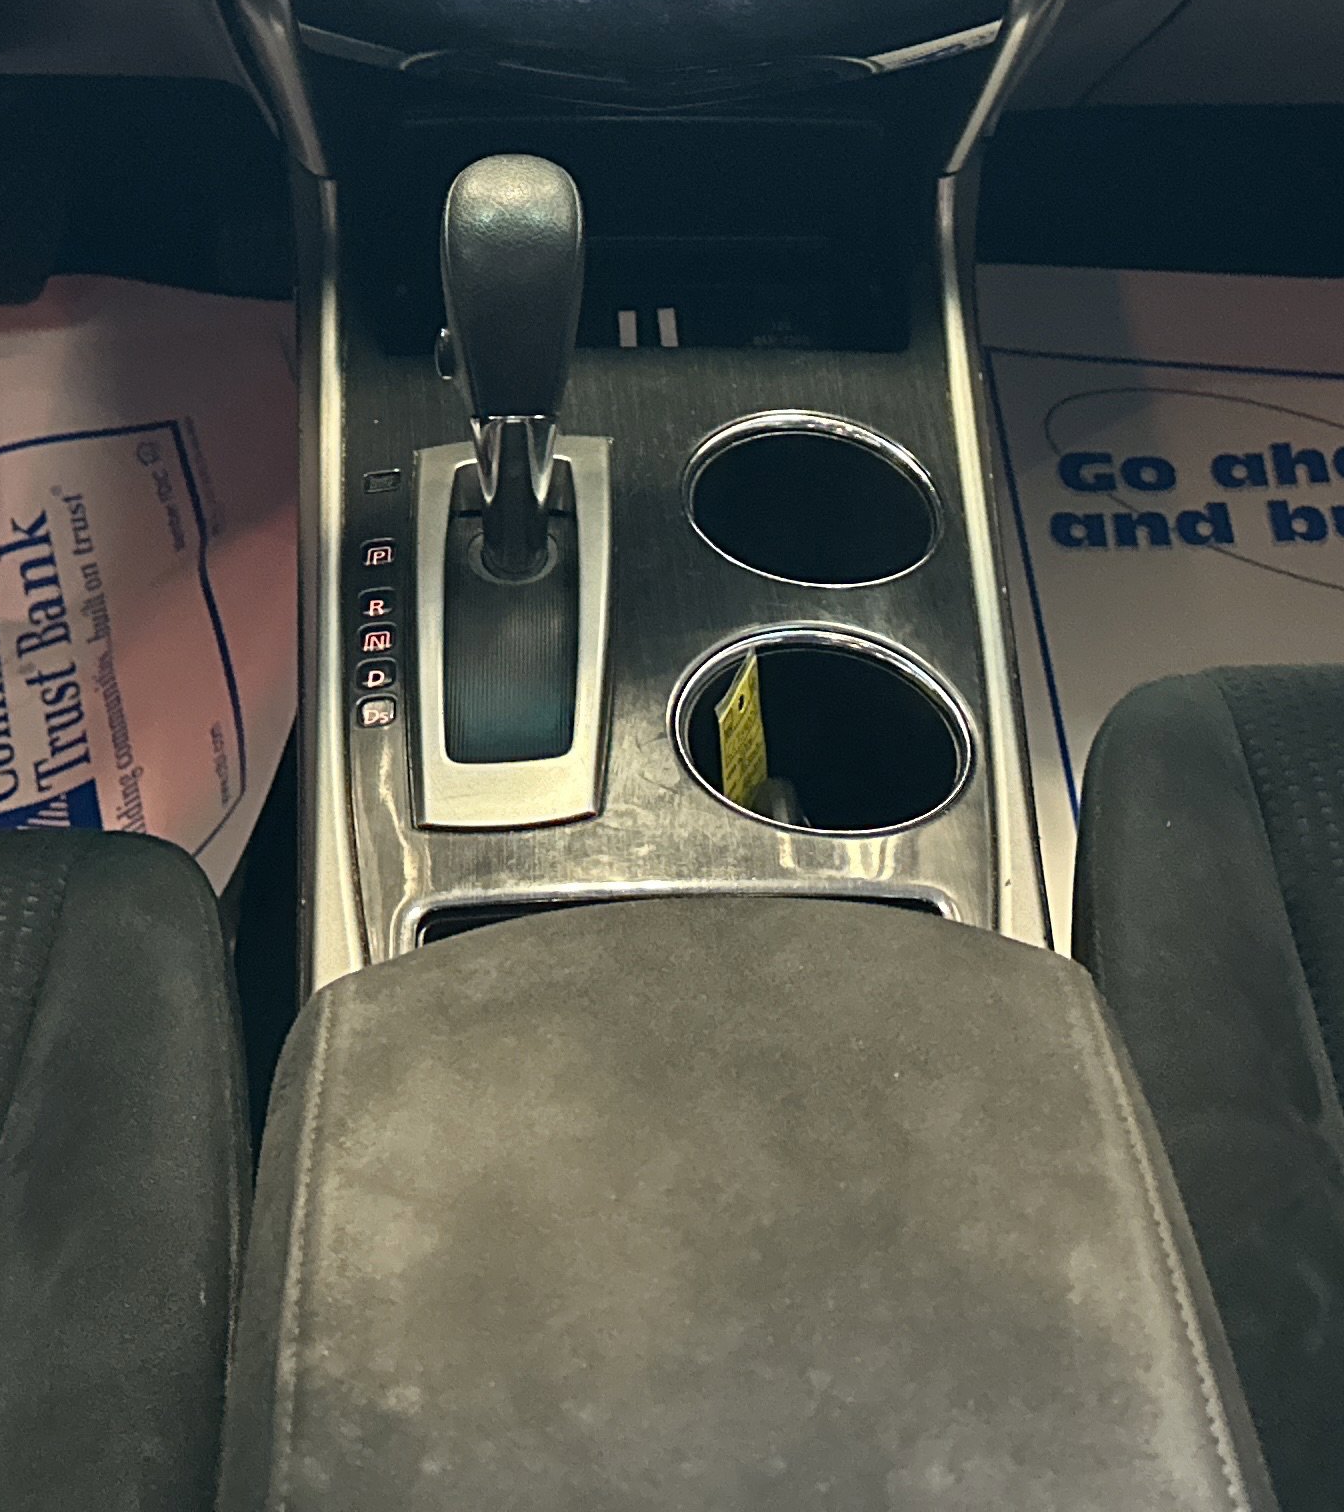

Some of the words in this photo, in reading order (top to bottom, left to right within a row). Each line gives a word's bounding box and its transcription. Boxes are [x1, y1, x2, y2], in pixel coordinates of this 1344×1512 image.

[1059, 451, 1177, 492] Go
[62, 493, 95, 556] trust
[1051, 501, 1234, 549] and
[81, 561, 102, 593] on
[368, 599, 385, 616] R
[367, 670, 385, 688] D
[26, 661, 94, 792] Trust
